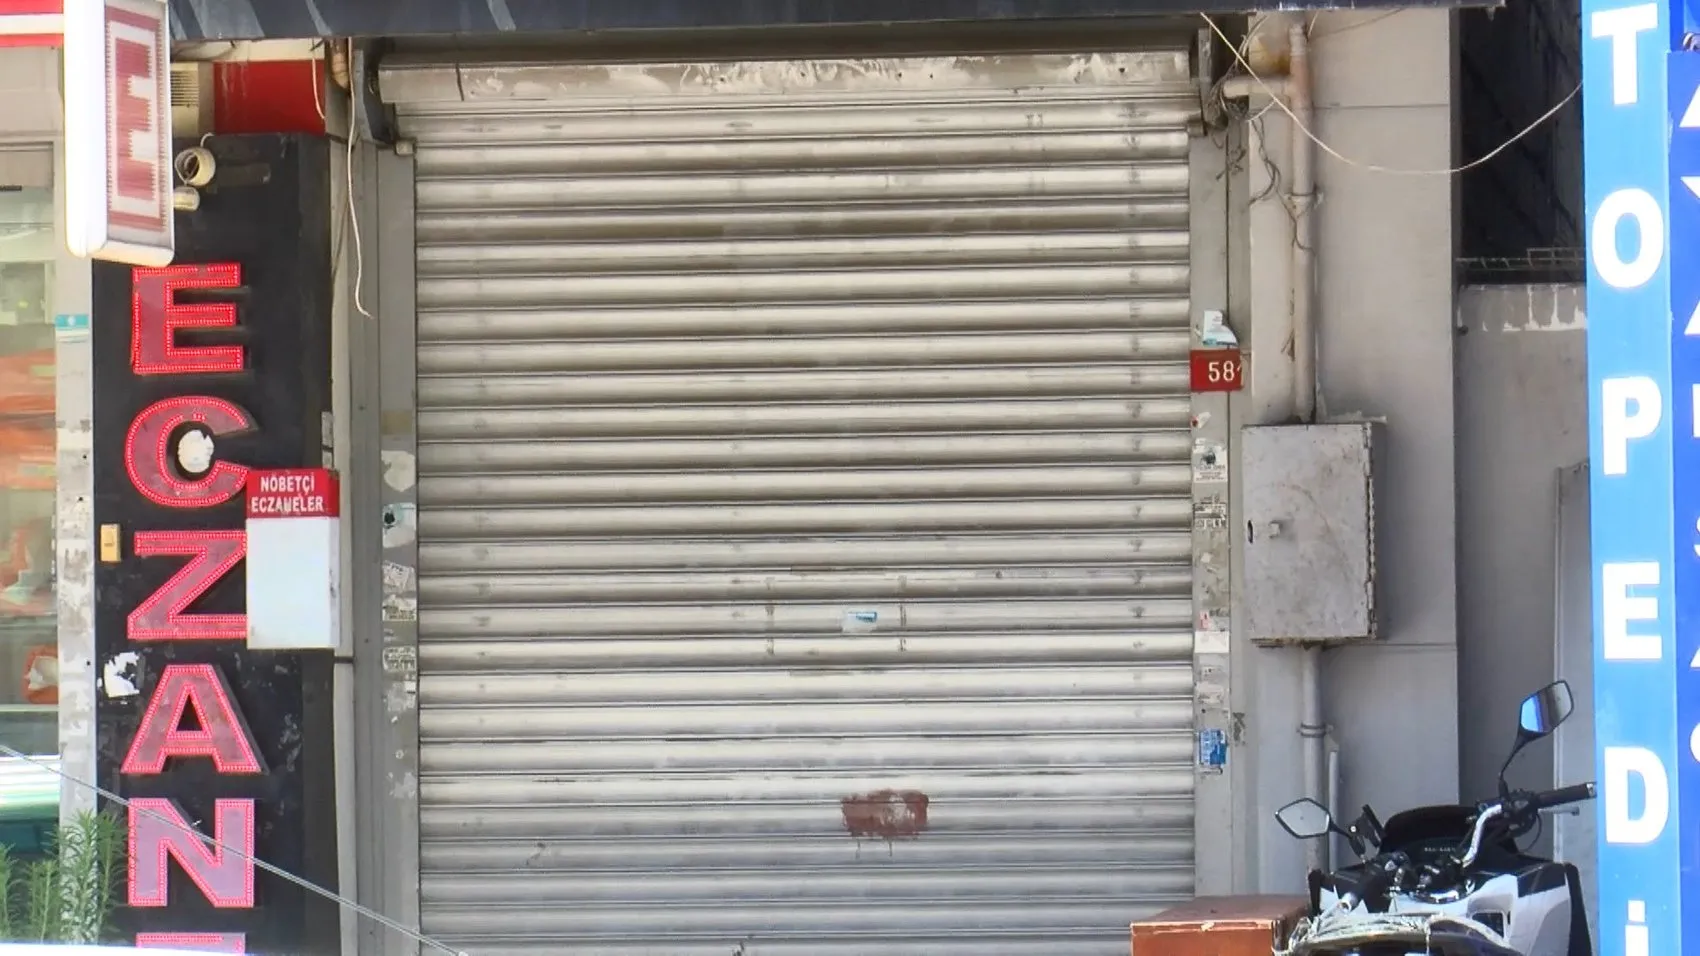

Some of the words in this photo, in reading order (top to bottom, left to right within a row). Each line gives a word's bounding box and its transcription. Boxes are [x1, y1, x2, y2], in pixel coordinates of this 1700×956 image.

[1208, 360, 1241, 383] 58
[261, 472, 315, 495] NÖBETÇİ
[121, 263, 262, 955] ECZAN
